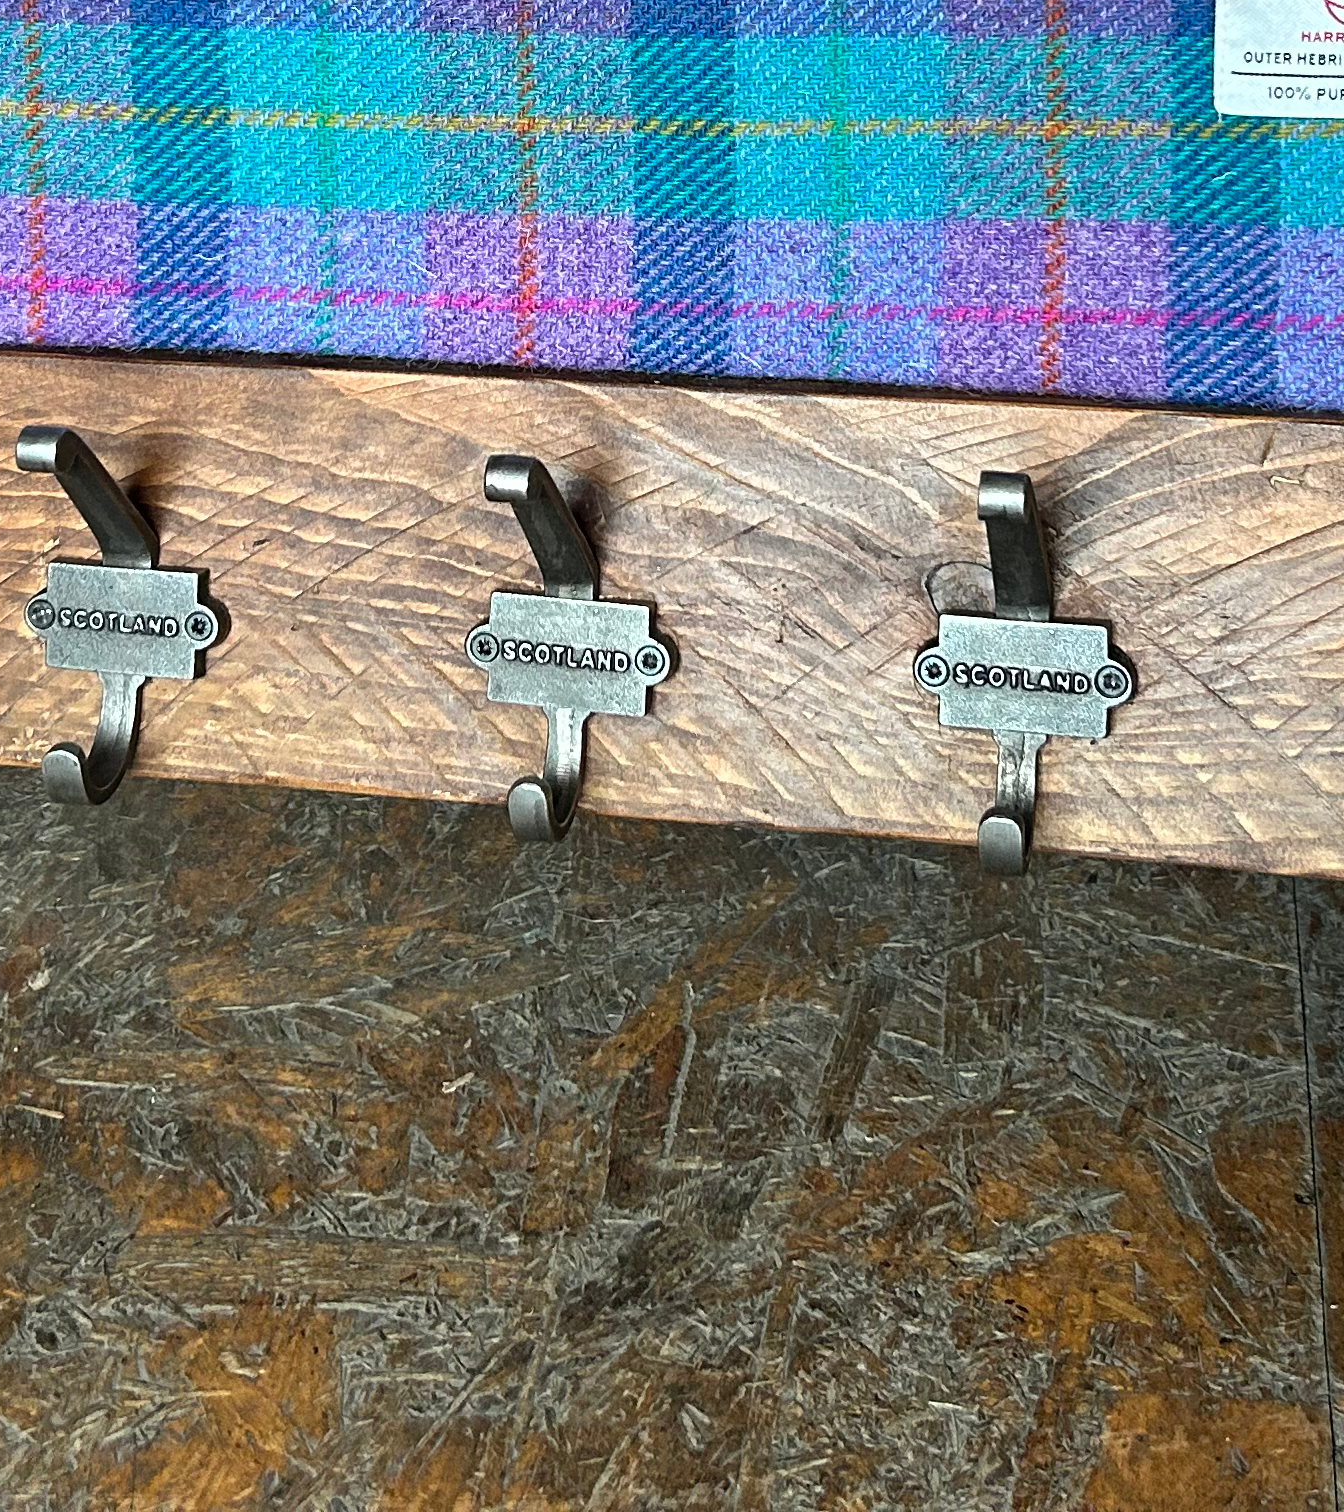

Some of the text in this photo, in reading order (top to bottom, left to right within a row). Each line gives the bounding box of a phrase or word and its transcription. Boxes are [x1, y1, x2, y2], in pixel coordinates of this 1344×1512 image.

[1243, 51, 1293, 66] OUTER
[1267, 86, 1312, 101] 100%
[58, 607, 179, 637] SCOTLAND
[502, 639, 631, 672] SCOTLAND
[954, 662, 1090, 694] SCOTLAND
